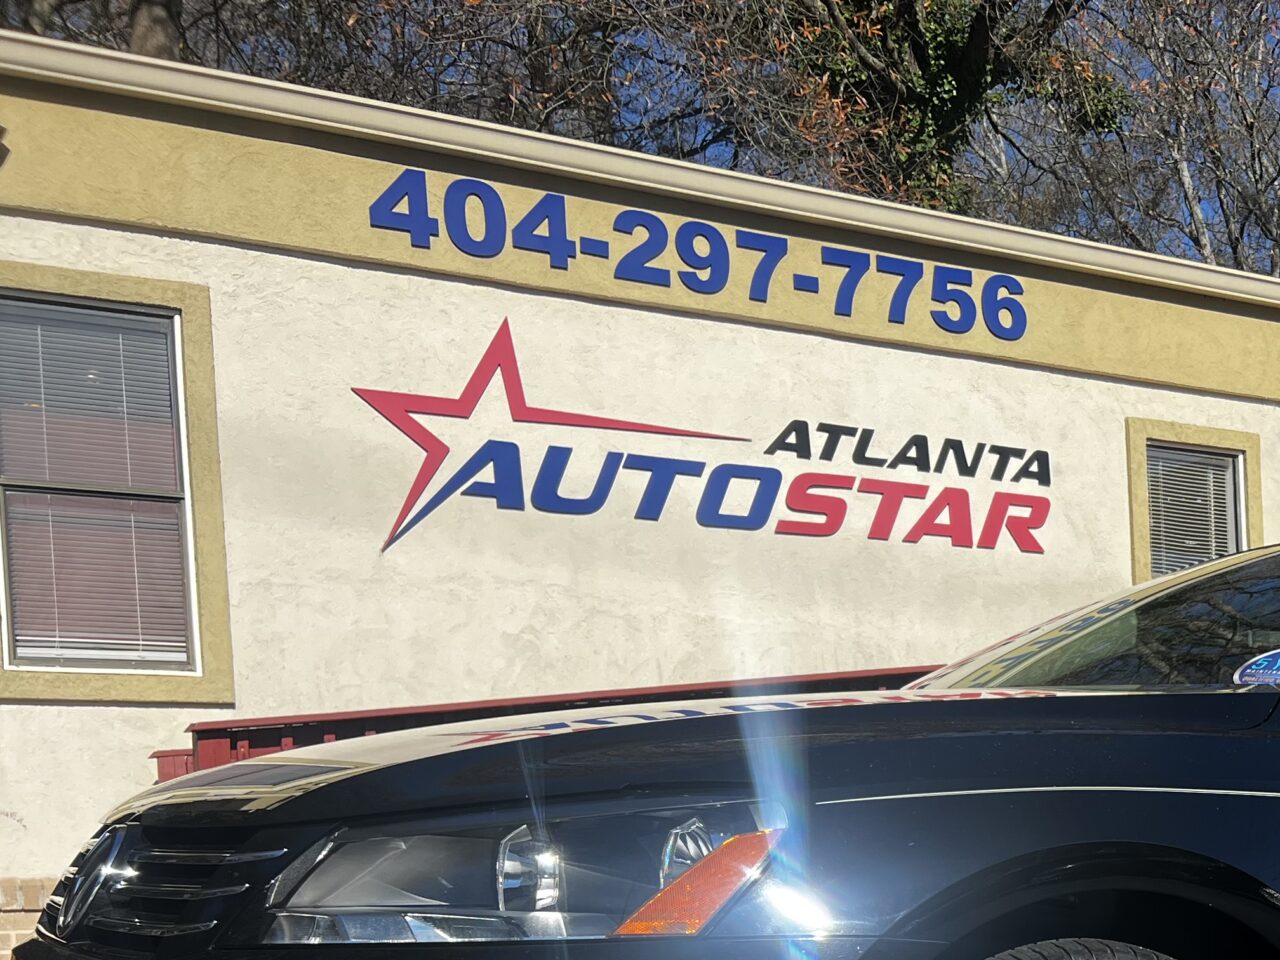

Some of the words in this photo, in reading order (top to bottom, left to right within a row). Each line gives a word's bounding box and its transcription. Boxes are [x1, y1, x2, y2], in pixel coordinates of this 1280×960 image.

[369, 168, 1028, 342] 404-297-7756
[764, 419, 1051, 487] ATLANTA
[1251, 658, 1271, 669] 5
